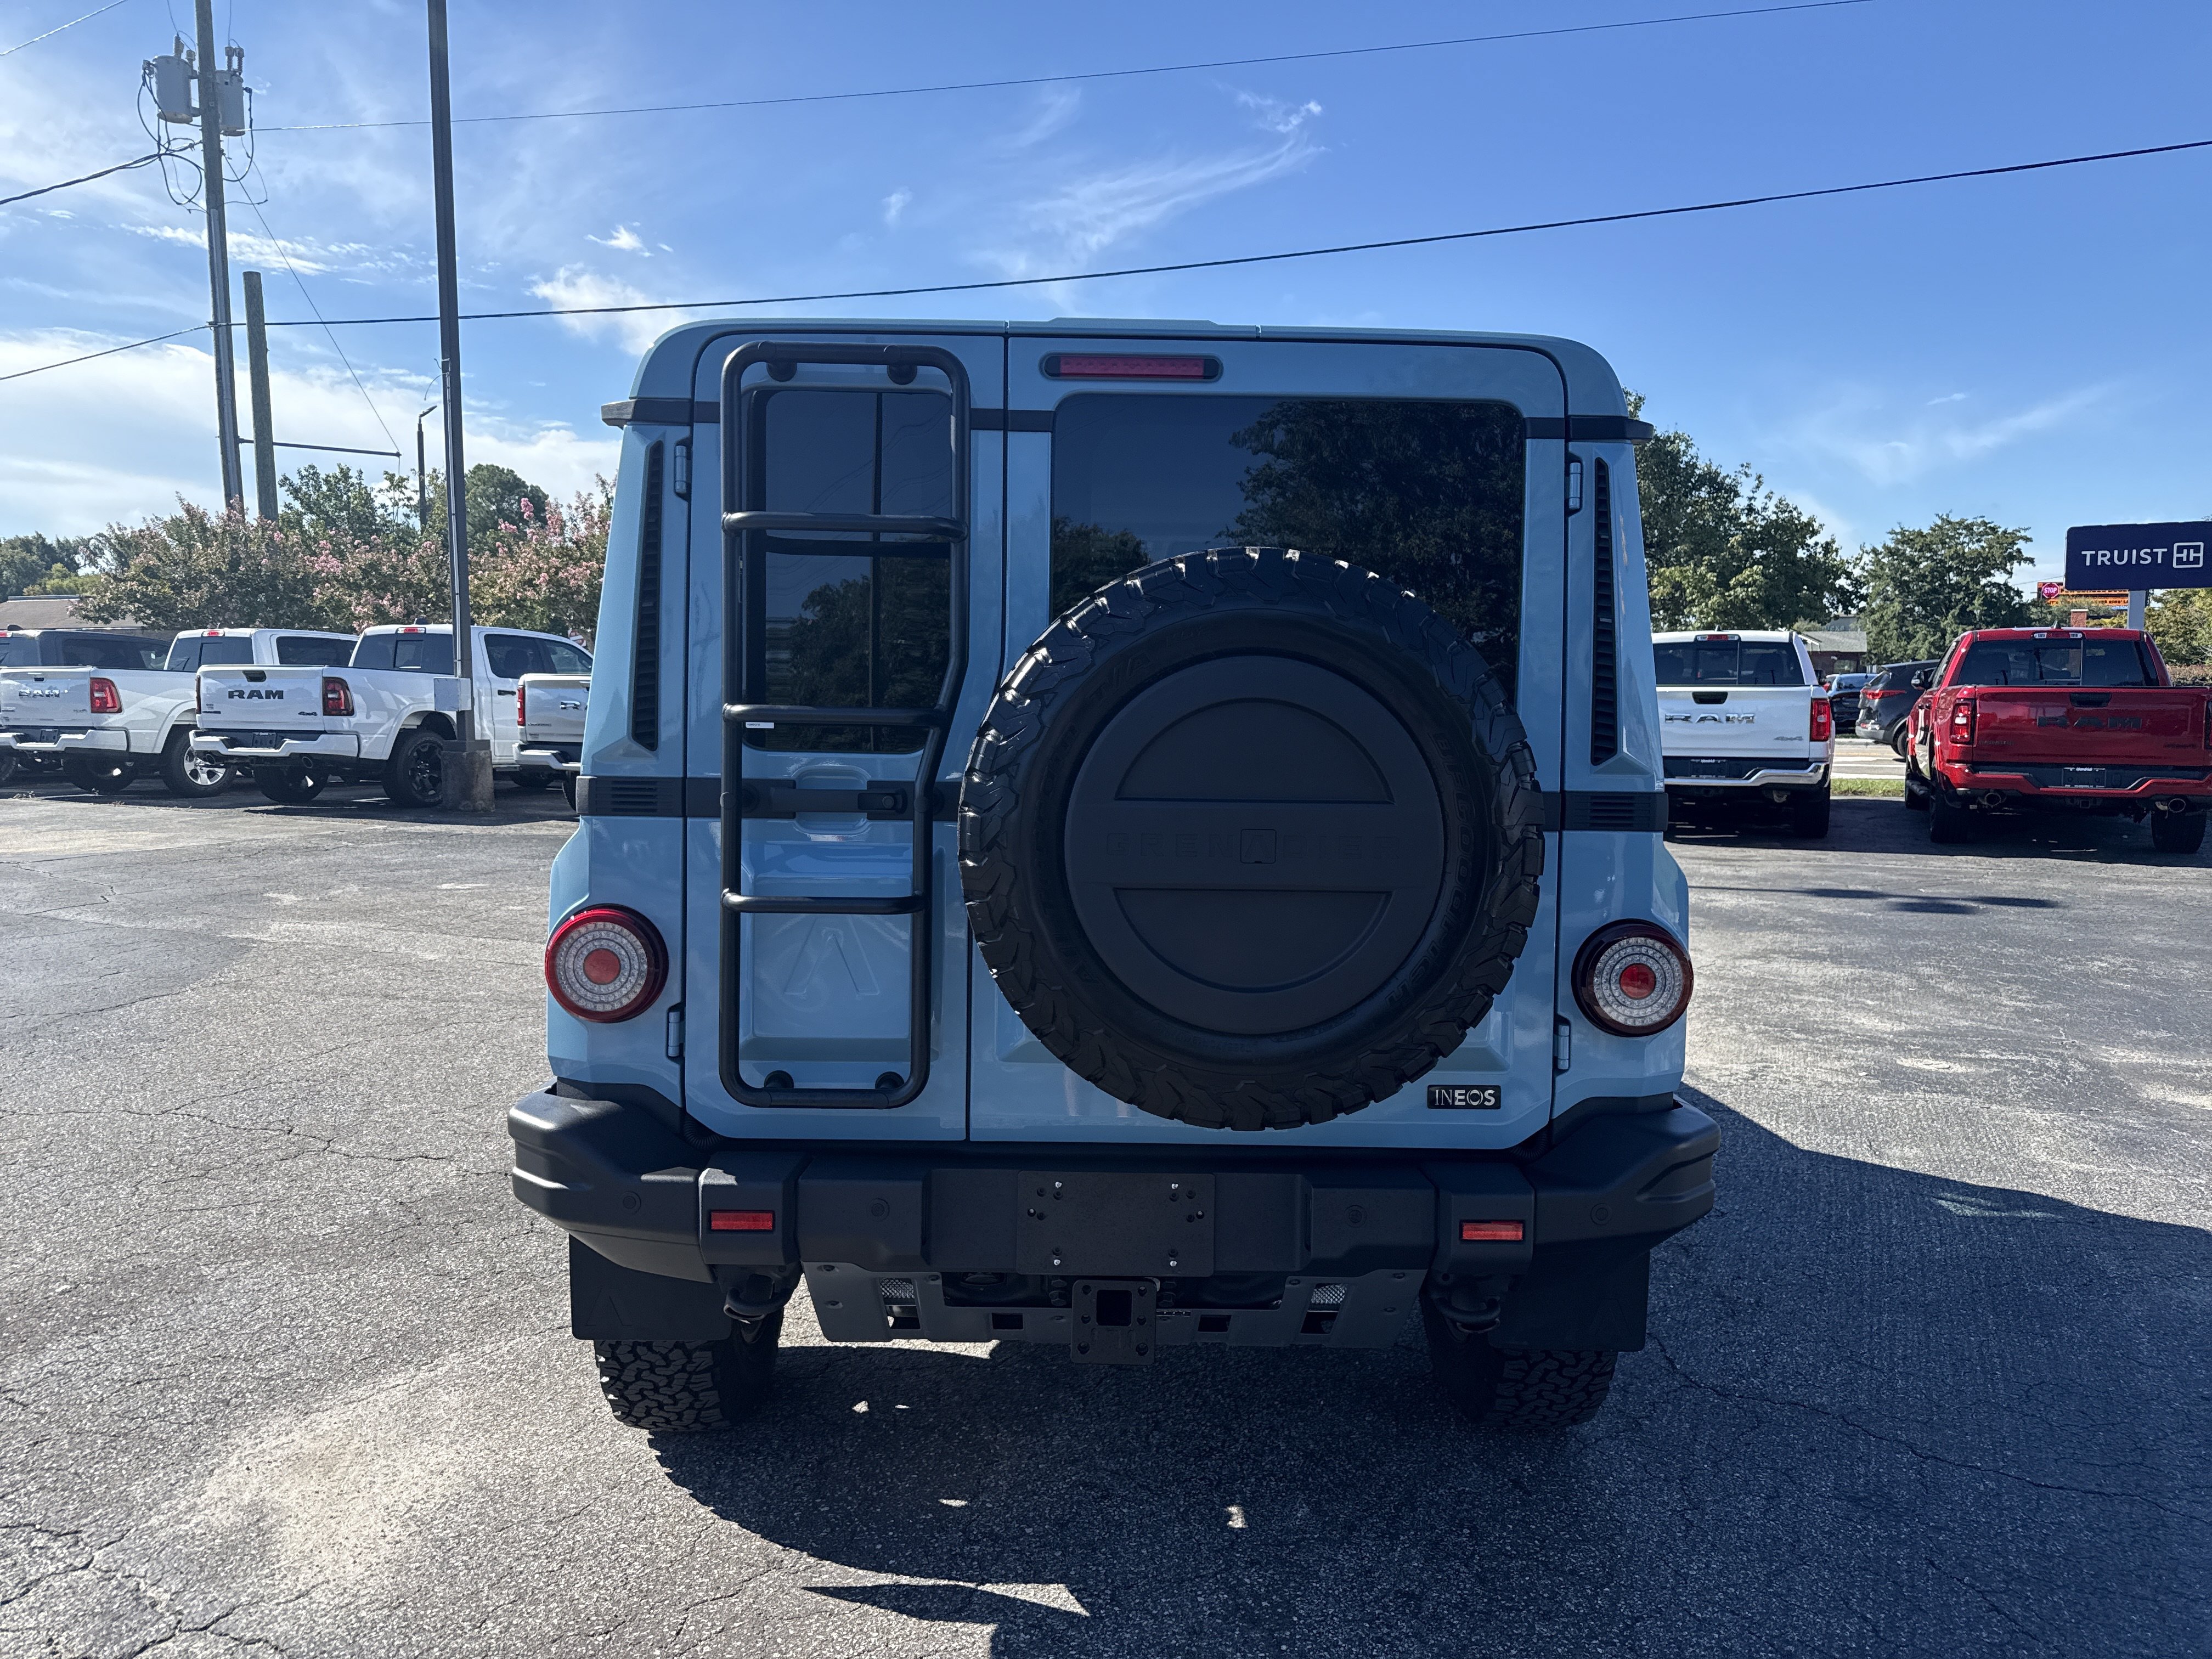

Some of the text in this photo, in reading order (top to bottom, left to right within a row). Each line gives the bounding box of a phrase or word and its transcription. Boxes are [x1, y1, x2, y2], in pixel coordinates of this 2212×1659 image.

[2081, 549, 2167, 566] TRUIST
[18, 689, 60, 697] RAM
[228, 690, 284, 699] RAM
[1665, 713, 1755, 724] RAM
[2036, 716, 2142, 729] RAM
[1106, 832, 1401, 860] GRENADIER
[1435, 1089, 1496, 1105] INEOS
